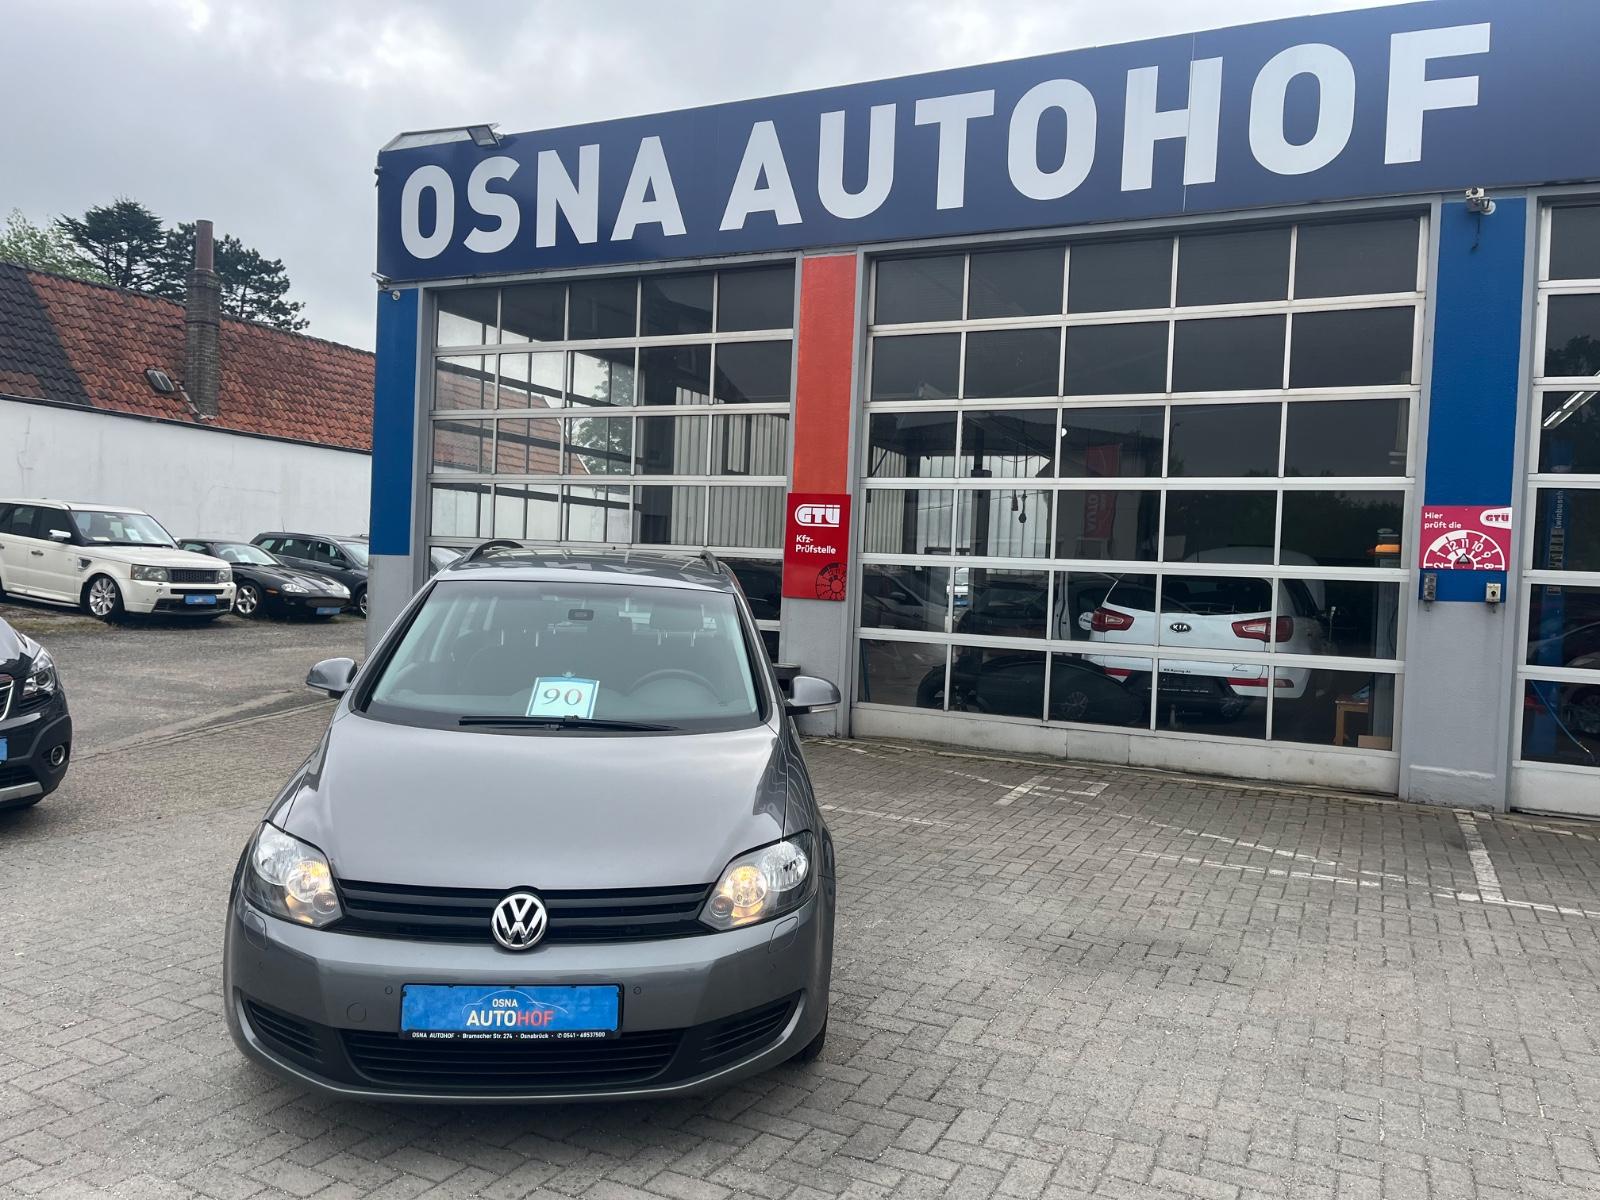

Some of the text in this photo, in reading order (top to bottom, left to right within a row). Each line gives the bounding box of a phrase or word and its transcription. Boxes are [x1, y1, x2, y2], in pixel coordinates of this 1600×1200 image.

[401, 22, 1491, 259] OSNA AUTOHOF
[1424, 522, 1447, 530] prüft
[796, 535, 813, 543] Kfz-
[1461, 539, 1469, 548] 11
[795, 544, 836, 554] Prüfstelle
[1446, 541, 1458, 551] 12
[1472, 540, 1483, 552] 10
[542, 688, 583, 706] 90
[492, 998, 518, 1008] OSNA
[466, 1009, 554, 1027] AUTOHOF
